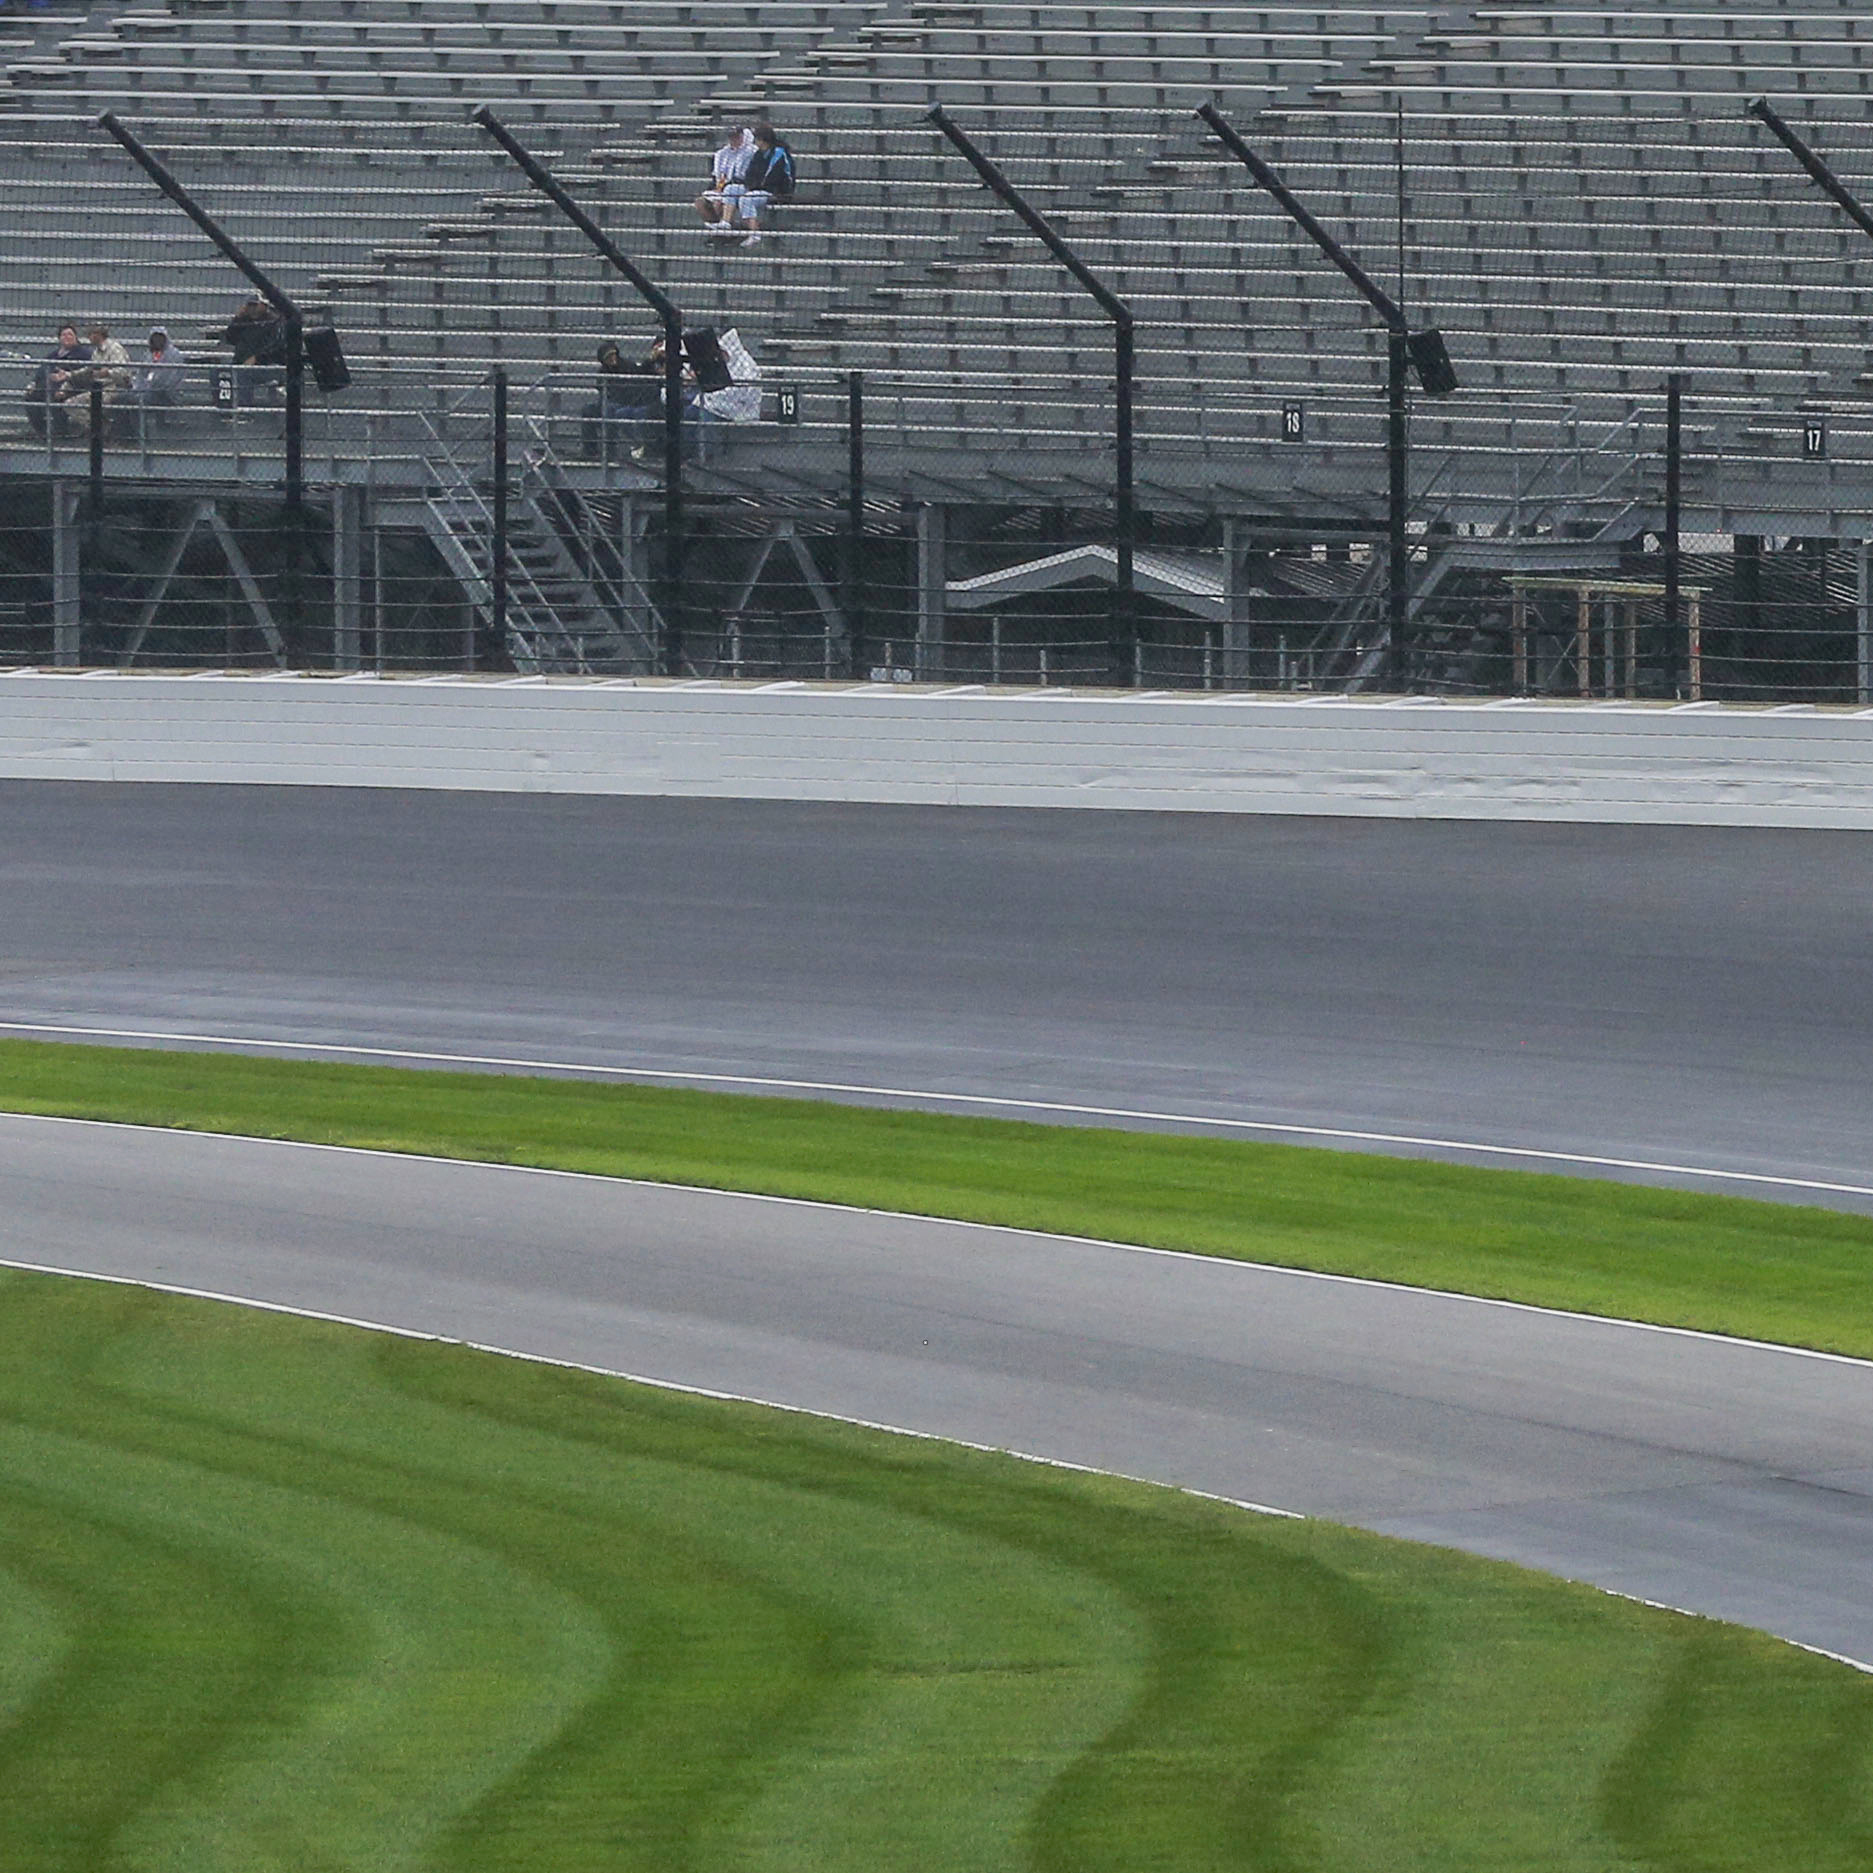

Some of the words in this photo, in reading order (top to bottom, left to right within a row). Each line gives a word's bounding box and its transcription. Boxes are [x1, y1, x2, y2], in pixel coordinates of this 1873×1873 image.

[781, 394, 795, 416] 19
[1287, 411, 1300, 433] 18
[1808, 429, 1821, 452] 17
